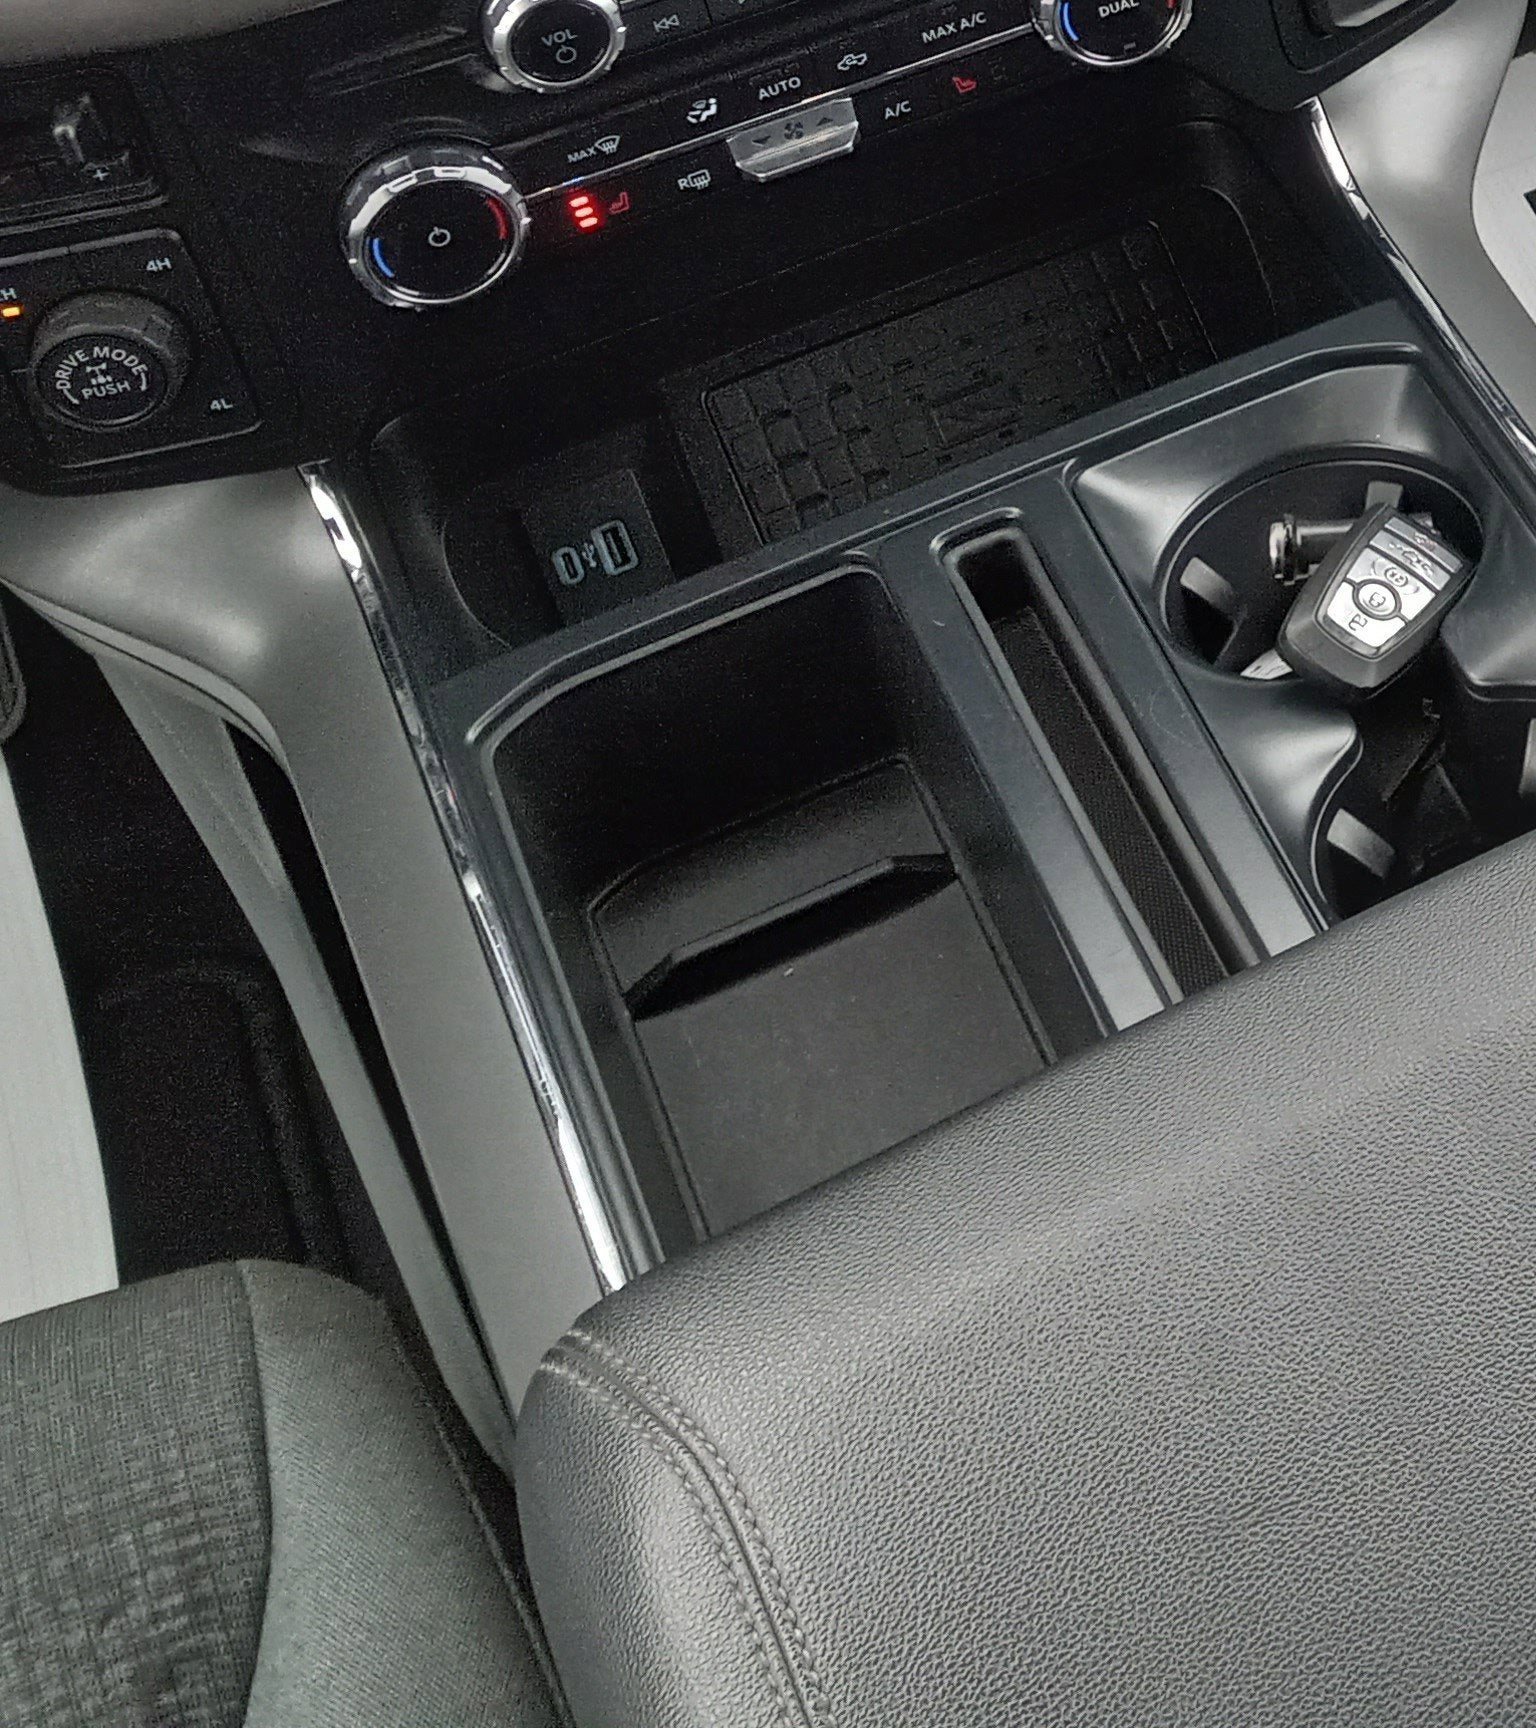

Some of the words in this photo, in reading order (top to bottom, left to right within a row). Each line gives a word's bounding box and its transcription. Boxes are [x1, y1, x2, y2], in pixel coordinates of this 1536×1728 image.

[921, 22, 958, 43] MAX
[959, 12, 987, 29] A/C
[541, 29, 578, 47] VOL
[758, 77, 801, 100] AUTO
[884, 100, 912, 119] A/C
[568, 146, 596, 163] MAX
[145, 258, 172, 272] 4H
[0, 288, 16, 299] H
[56, 349, 90, 391] DRIVE
[93, 346, 148, 375] MODE
[81, 380, 131, 399] PUSH
[210, 398, 234, 411] 4L
